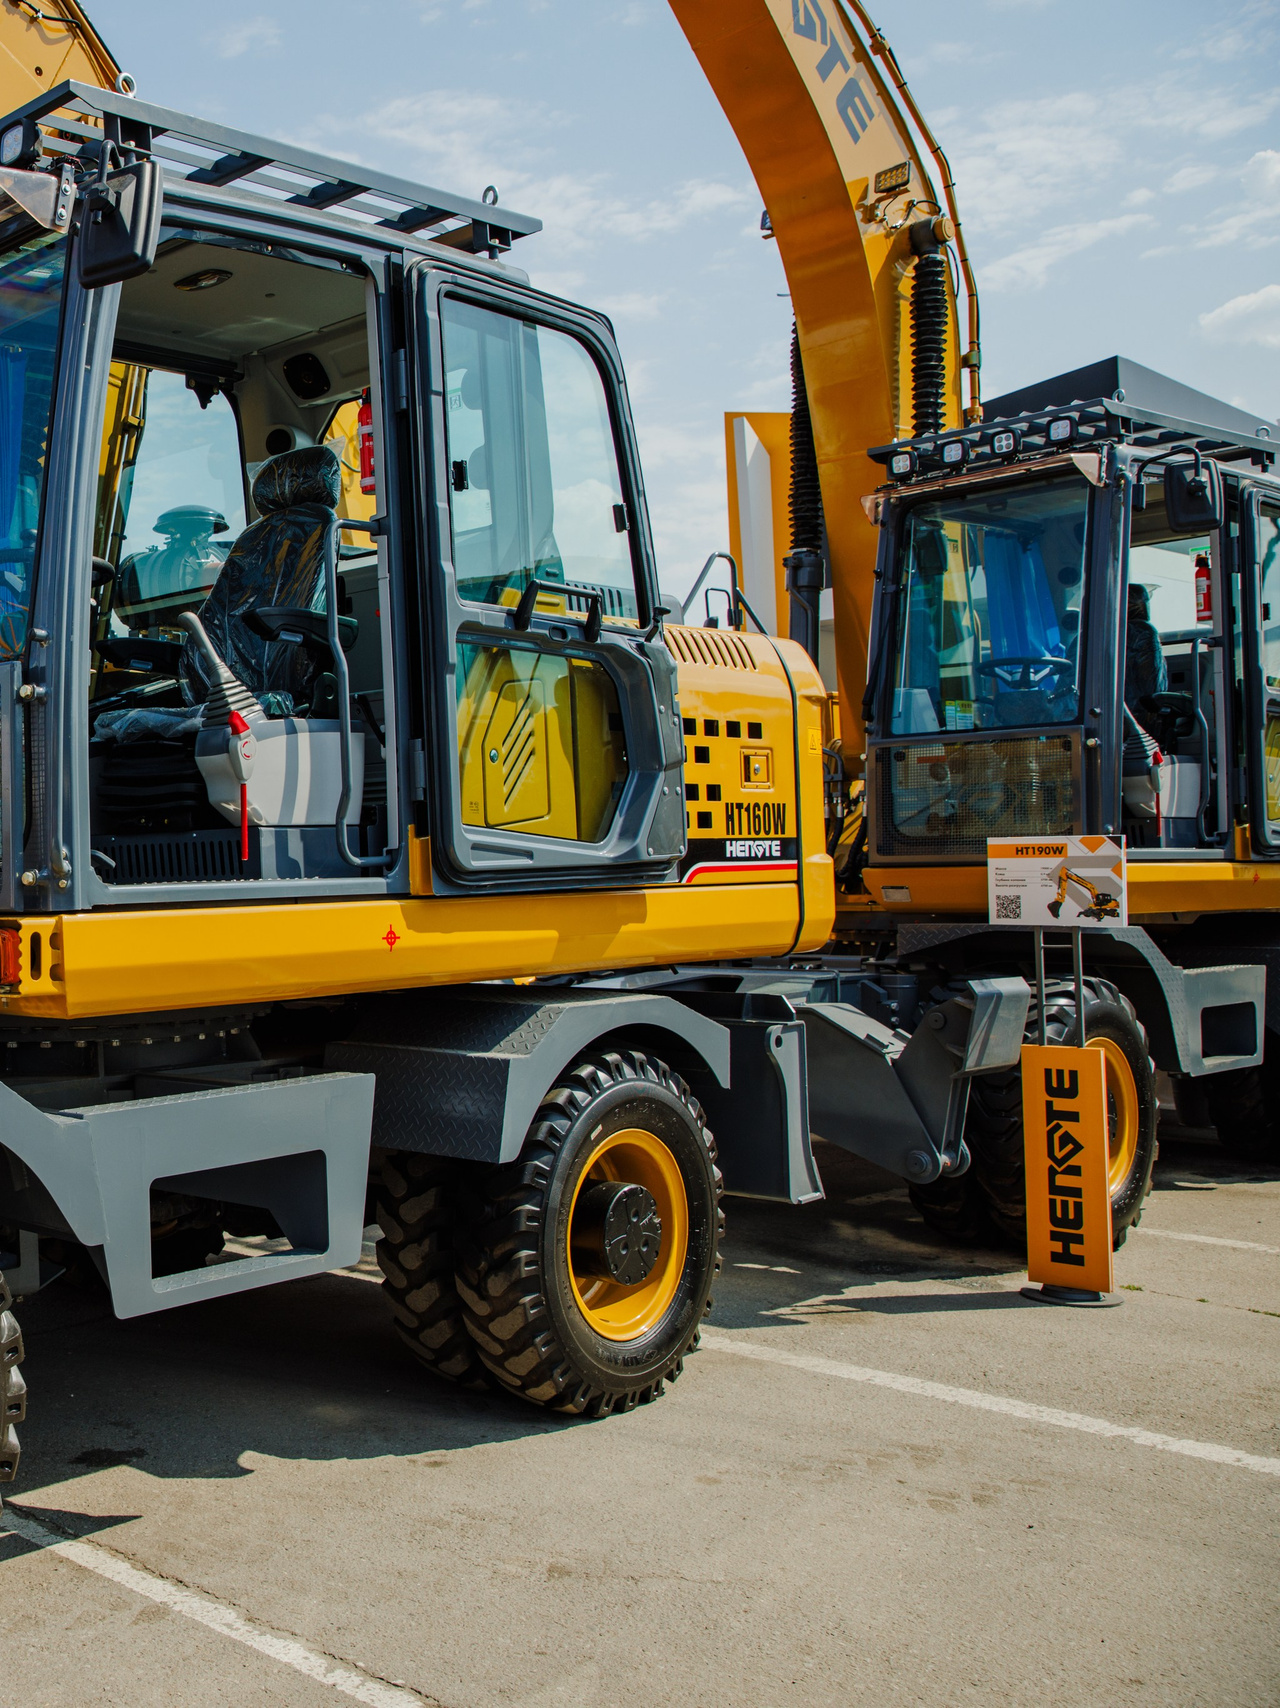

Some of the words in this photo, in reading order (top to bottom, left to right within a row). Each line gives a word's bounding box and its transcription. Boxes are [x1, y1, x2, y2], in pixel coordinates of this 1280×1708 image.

[725, 802, 786, 836] HT160W
[1015, 846, 1064, 856] HT190W
[1043, 1067, 1086, 1267] HENGTE
